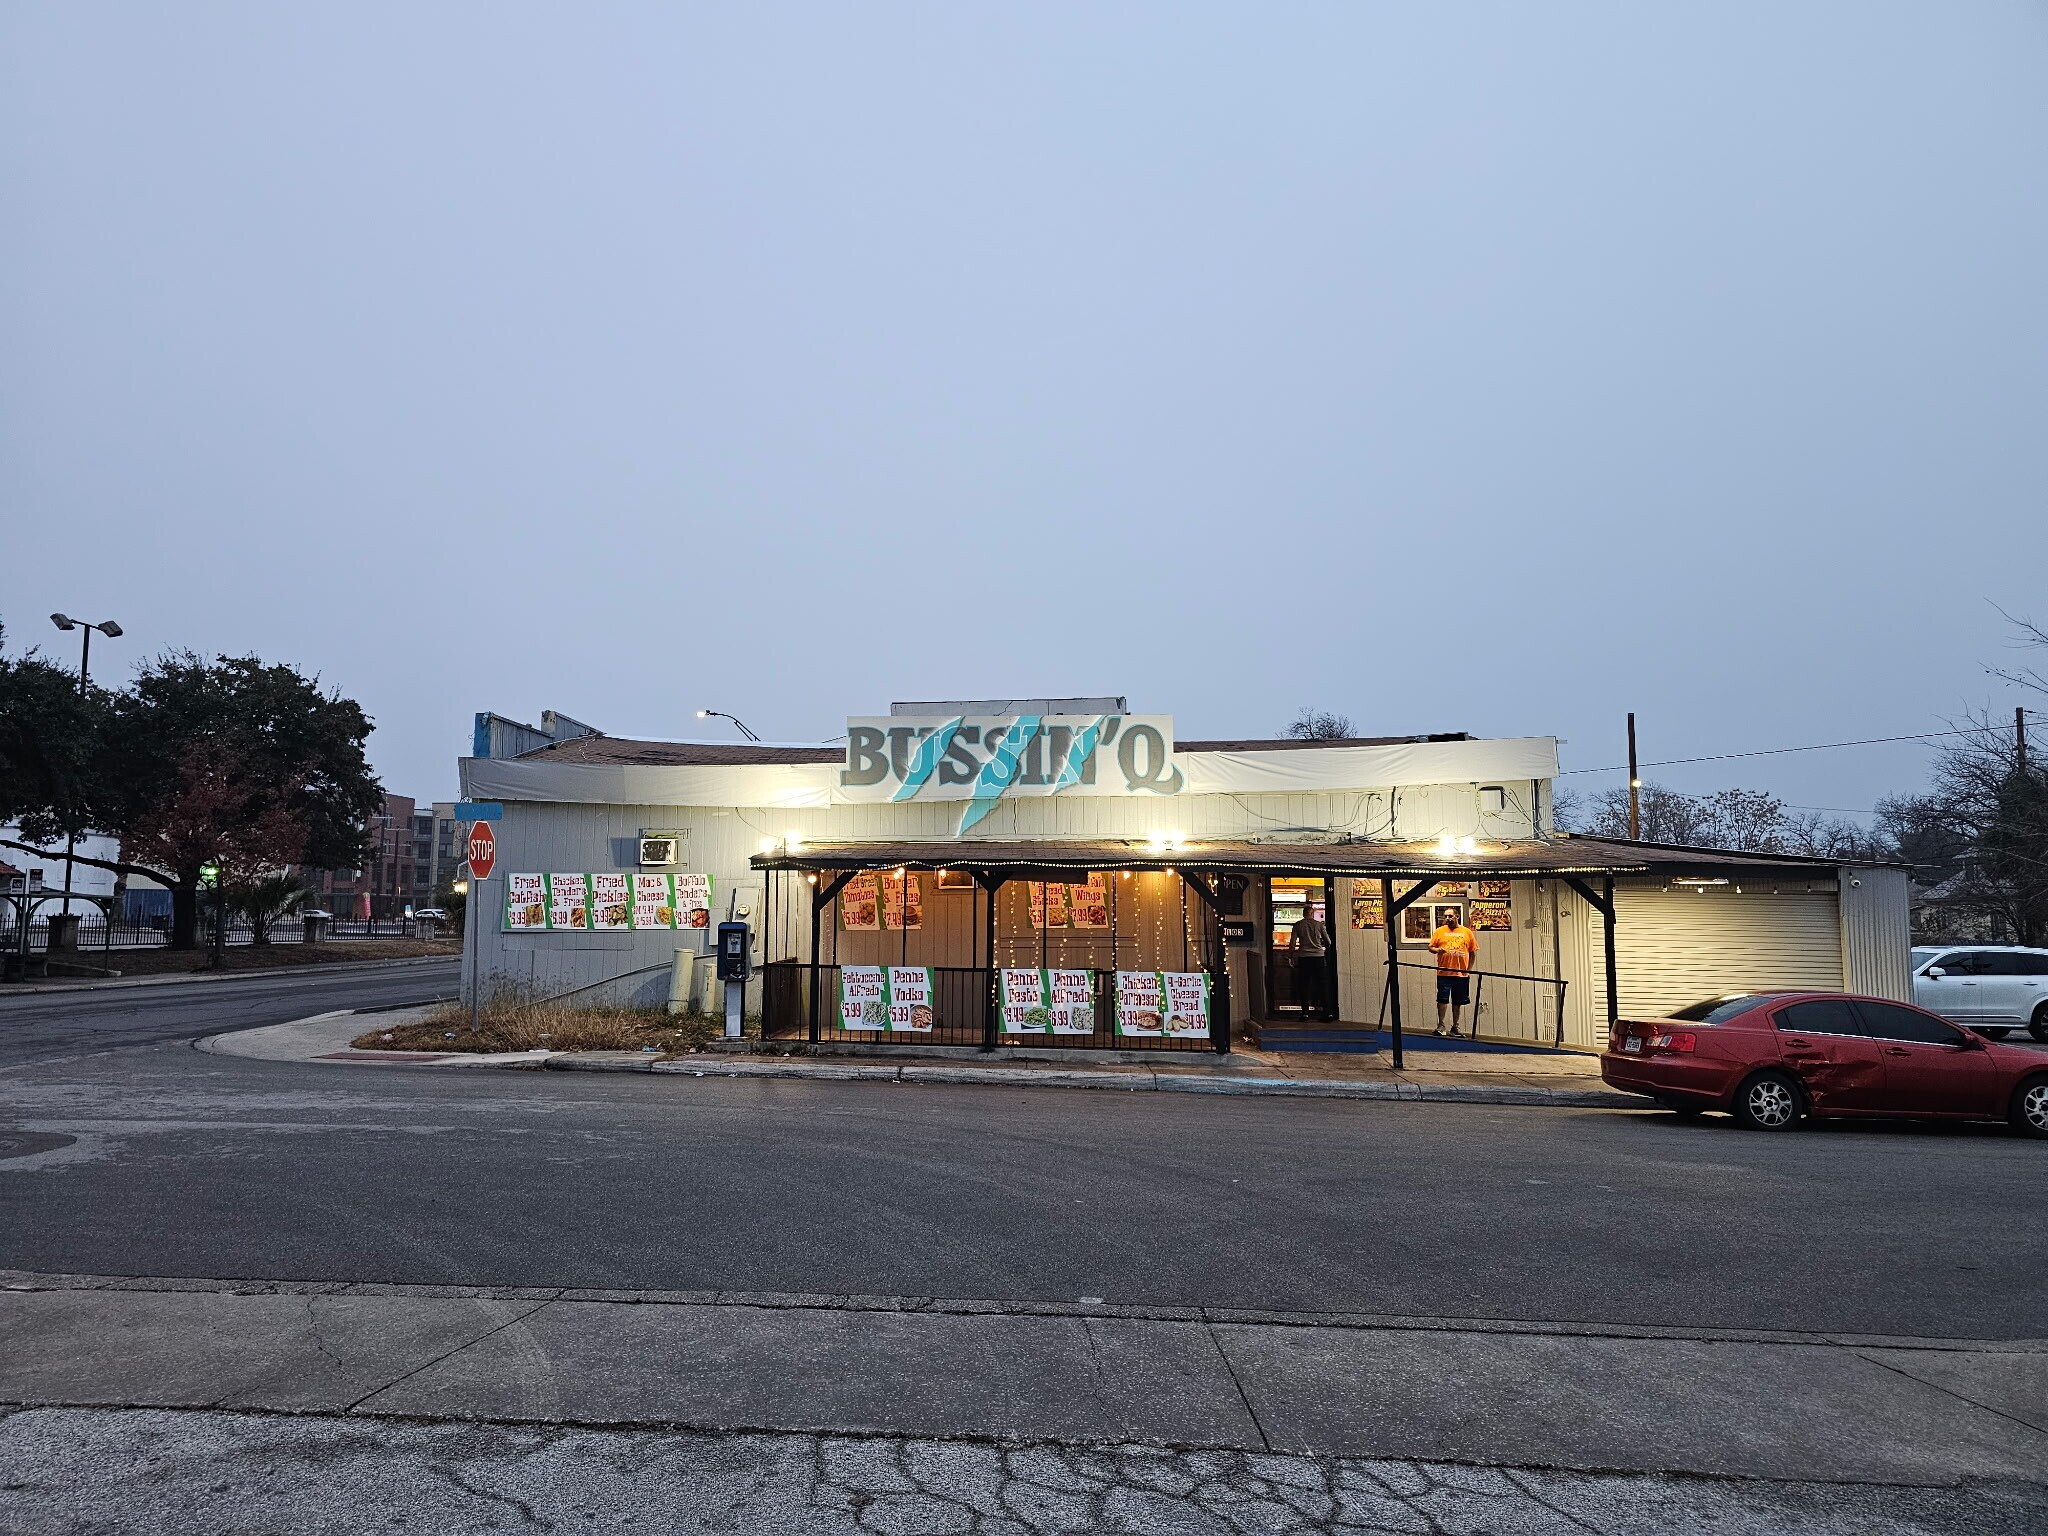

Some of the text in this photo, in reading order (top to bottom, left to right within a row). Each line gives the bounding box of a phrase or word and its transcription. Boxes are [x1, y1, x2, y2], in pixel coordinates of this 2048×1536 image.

[470, 839, 493, 861] STOP
[514, 876, 541, 889] Fried
[552, 876, 586, 886] Chicken
[597, 875, 625, 888] Fried
[638, 876, 663, 888] Mac &
[677, 875, 706, 887] Buffalo
[1223, 879, 1244, 890] PEN
[552, 887, 587, 897] Tenders
[592, 890, 629, 903] Pickles
[636, 890, 665, 902] Cheese
[676, 887, 708, 899] Tenders
[844, 889, 875, 903] Tomatoes
[1038, 884, 1063, 896] Bead
[1075, 889, 1101, 904] Wings
[509, 891, 546, 904] Catfish
[553, 897, 585, 907] & Fries
[883, 892, 891, 904] &
[1354, 899, 1383, 907] Large Piz
[1470, 900, 1508, 911] Pepperoni
[550, 911, 568, 925] $6.99
[592, 908, 609, 923] $5.99
[843, 910, 861, 926] $5.99
[1069, 908, 1088, 923] $7.99
[843, 971, 885, 984] Fettuccine
[893, 970, 924, 983] Penne
[1006, 972, 1039, 986] Penne
[1053, 973, 1086, 987] Penne
[1122, 975, 1158, 990] Chicken
[1167, 976, 1202, 988] 4-Garlic
[849, 984, 880, 997] Alfredo
[894, 987, 924, 1001] Vodka
[1008, 988, 1038, 1003] Pesto
[1051, 988, 1091, 1003] Alfredo
[1170, 988, 1200, 1000] Cheese
[1119, 989, 1160, 1006] Parmesan
[841, 1001, 861, 1018] $5.99
[1172, 1000, 1199, 1012] Bread
[888, 1005, 909, 1022] $5.99
[1004, 1006, 1024, 1023] $6.49
[1048, 1009, 1068, 1026] $6.99
[1185, 1012, 1206, 1030] $4.99
